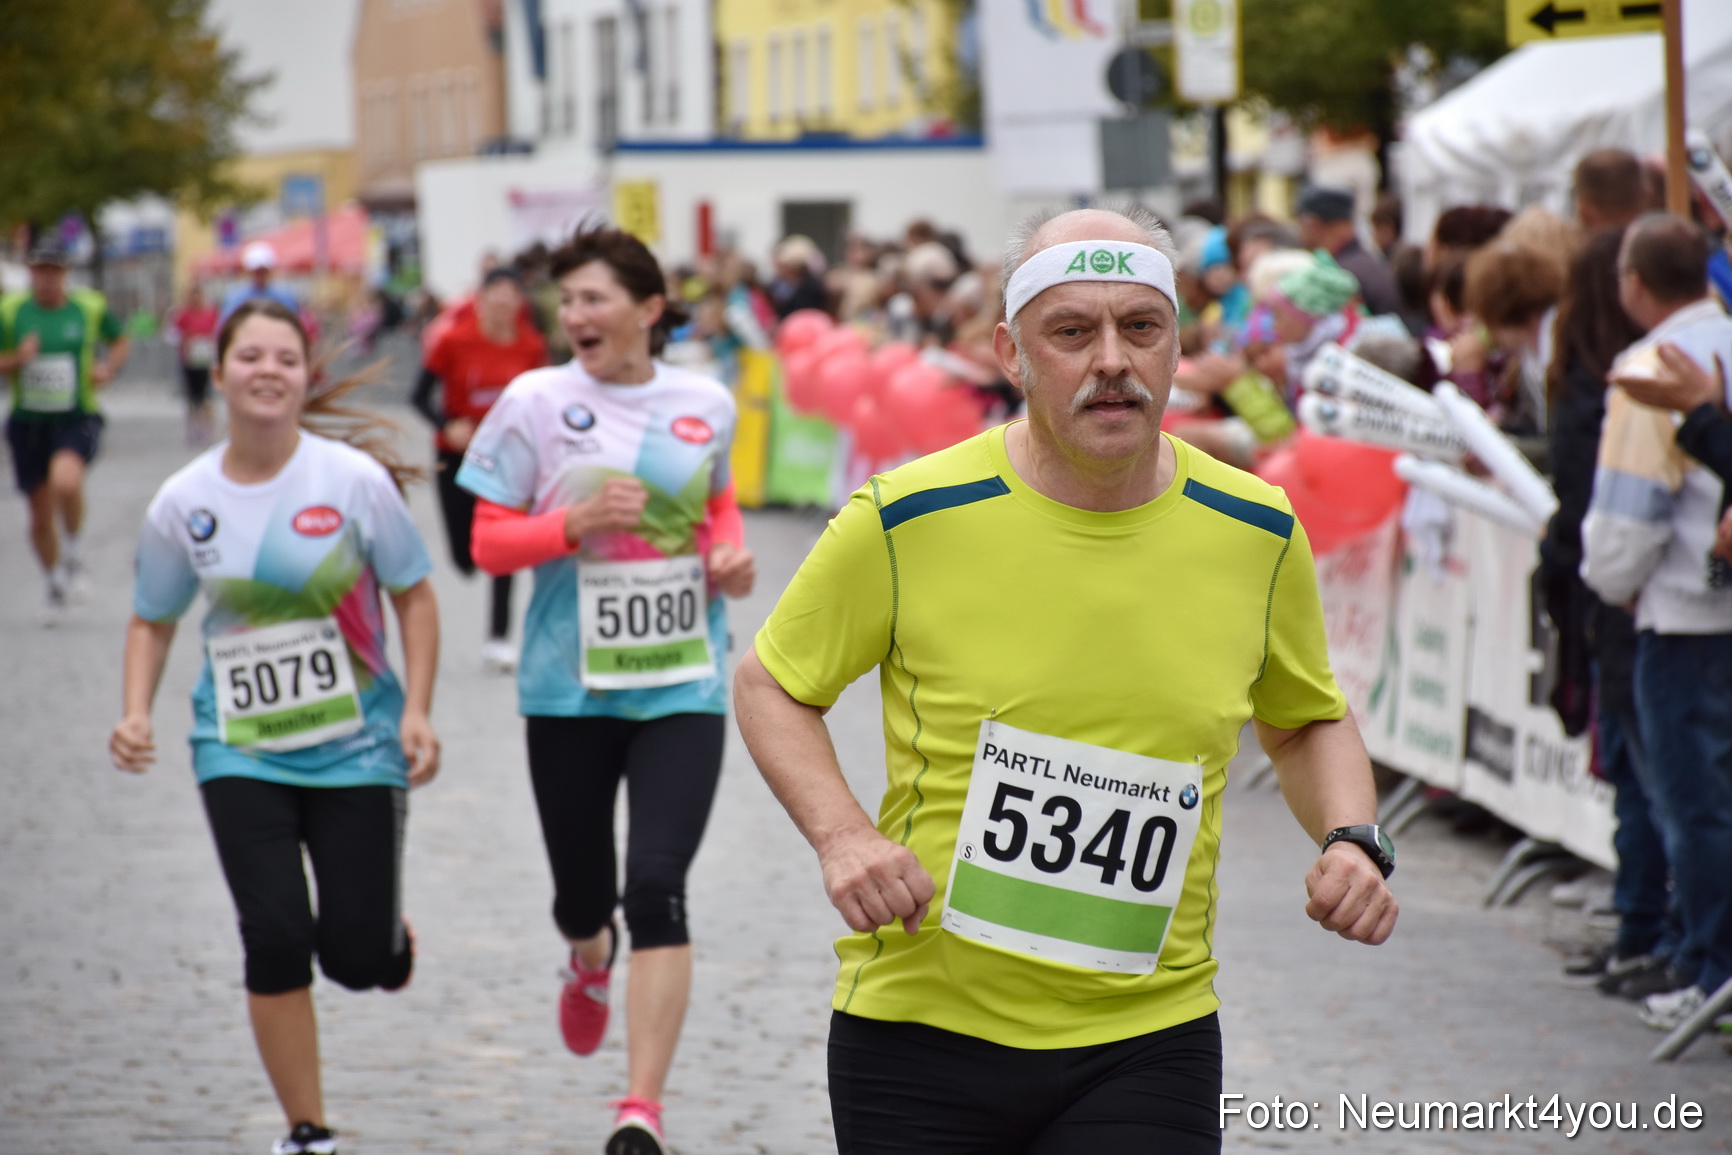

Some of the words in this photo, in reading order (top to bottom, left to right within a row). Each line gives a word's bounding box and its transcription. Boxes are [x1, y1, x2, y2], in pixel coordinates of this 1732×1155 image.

[1065, 249, 1136, 276] AOK
[597, 589, 696, 639] 5080
[230, 649, 337, 709] 5079
[983, 743, 1056, 780] PARTL
[1063, 764, 1170, 803] Neumarkt
[964, 845, 972, 859] S
[983, 781, 1177, 892] 5340
